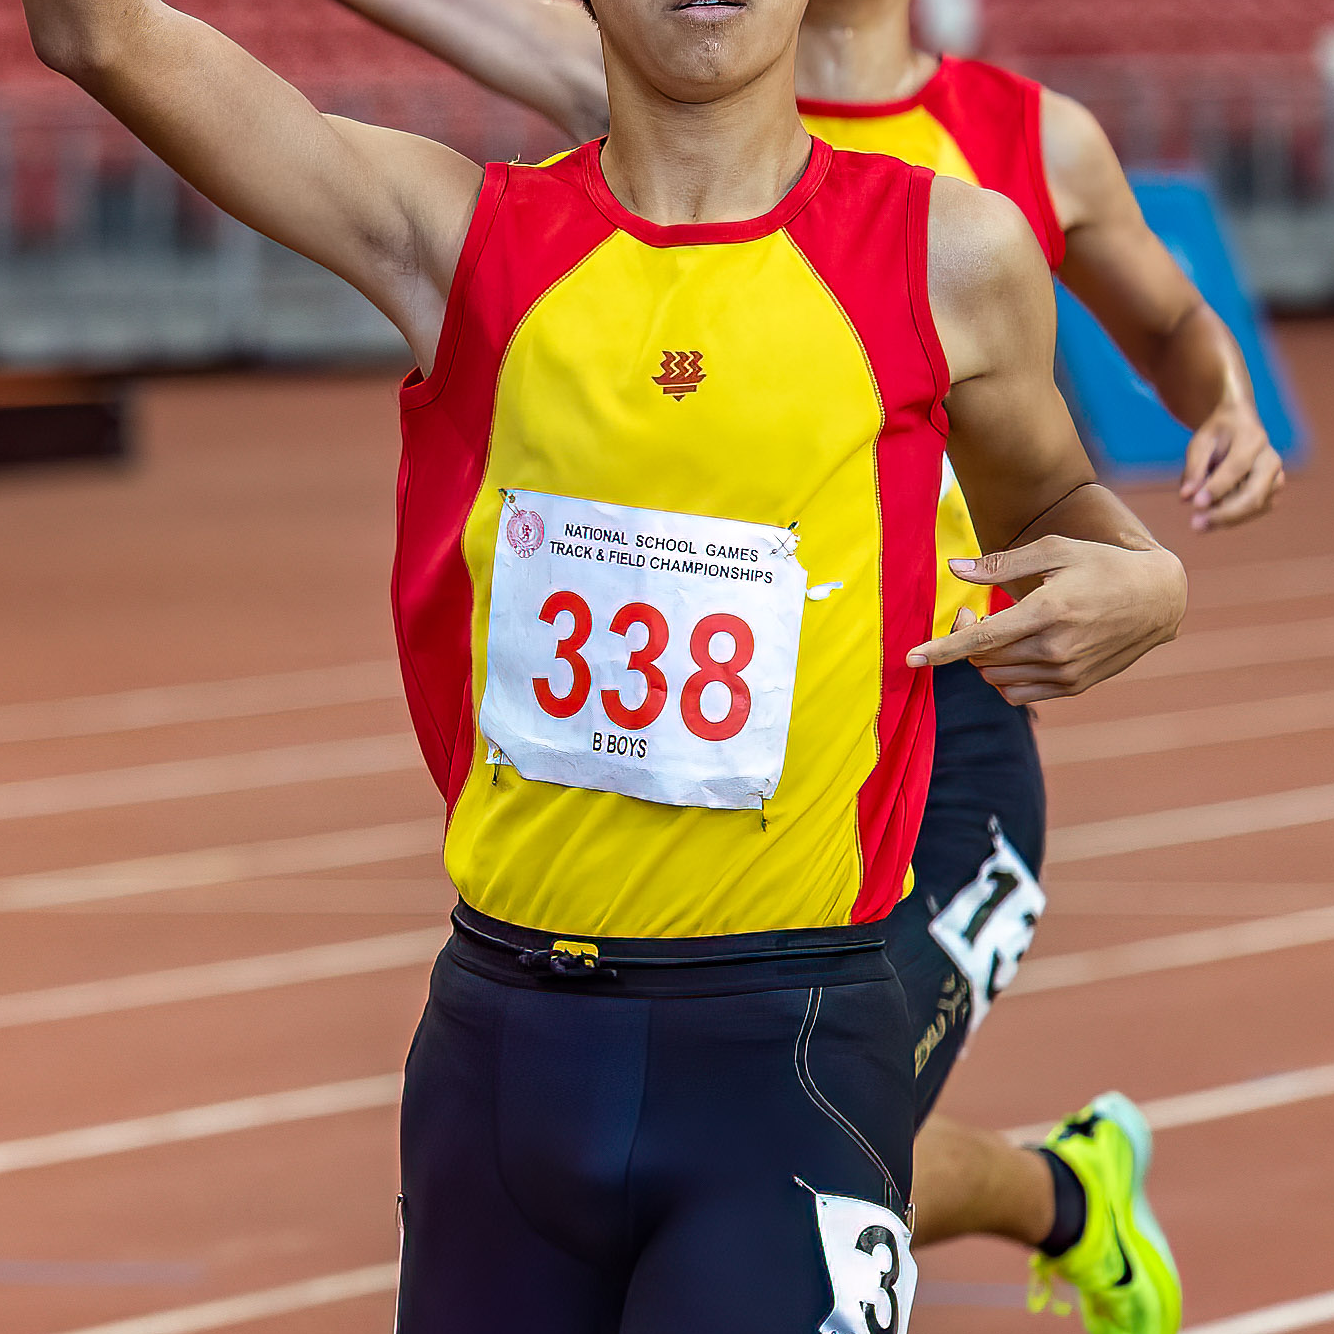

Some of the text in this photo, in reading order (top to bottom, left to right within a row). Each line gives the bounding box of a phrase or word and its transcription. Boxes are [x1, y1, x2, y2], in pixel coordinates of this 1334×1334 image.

[549, 541, 773, 584] TRACK & FIELD CHAMPIONSHIPS
[564, 523, 759, 563] NATIONAL SCHOOL GAMES
[532, 590, 755, 742] 338
[593, 733, 647, 758] B BOYS
